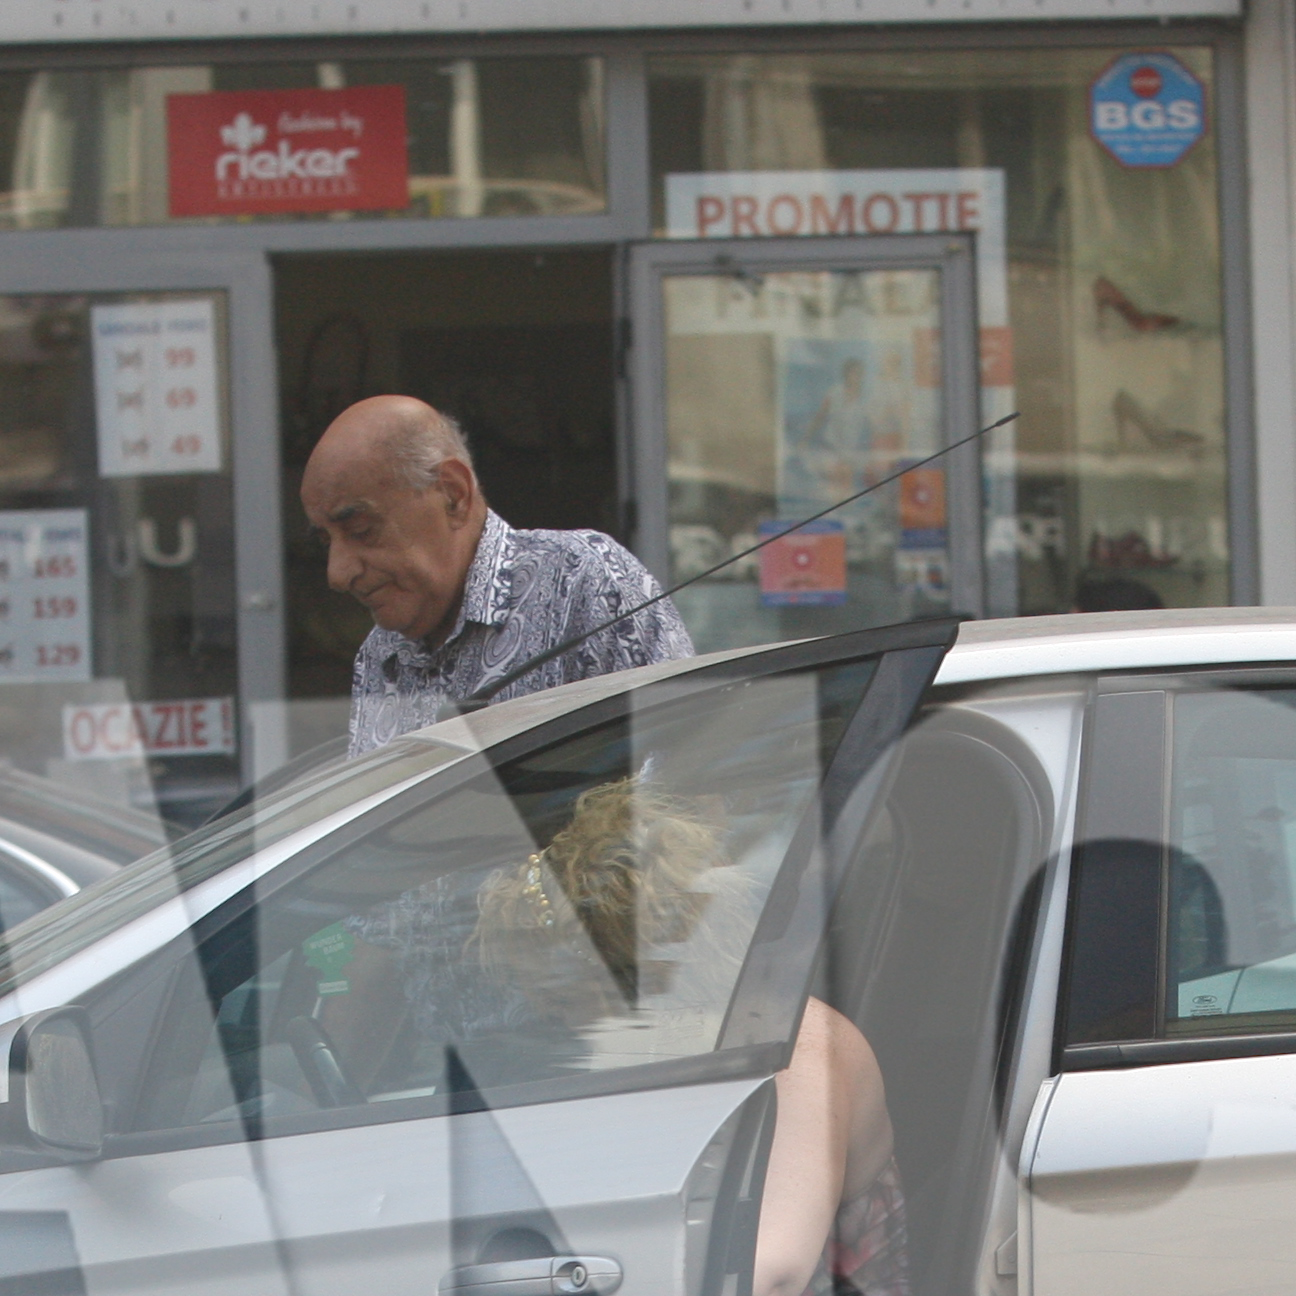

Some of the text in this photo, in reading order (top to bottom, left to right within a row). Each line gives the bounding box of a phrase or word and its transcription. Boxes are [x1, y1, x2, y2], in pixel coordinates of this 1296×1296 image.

[1095, 100, 1200, 130] BGS
[215, 140, 359, 181] rieker
[71, 703, 208, 753] OCAZIE
